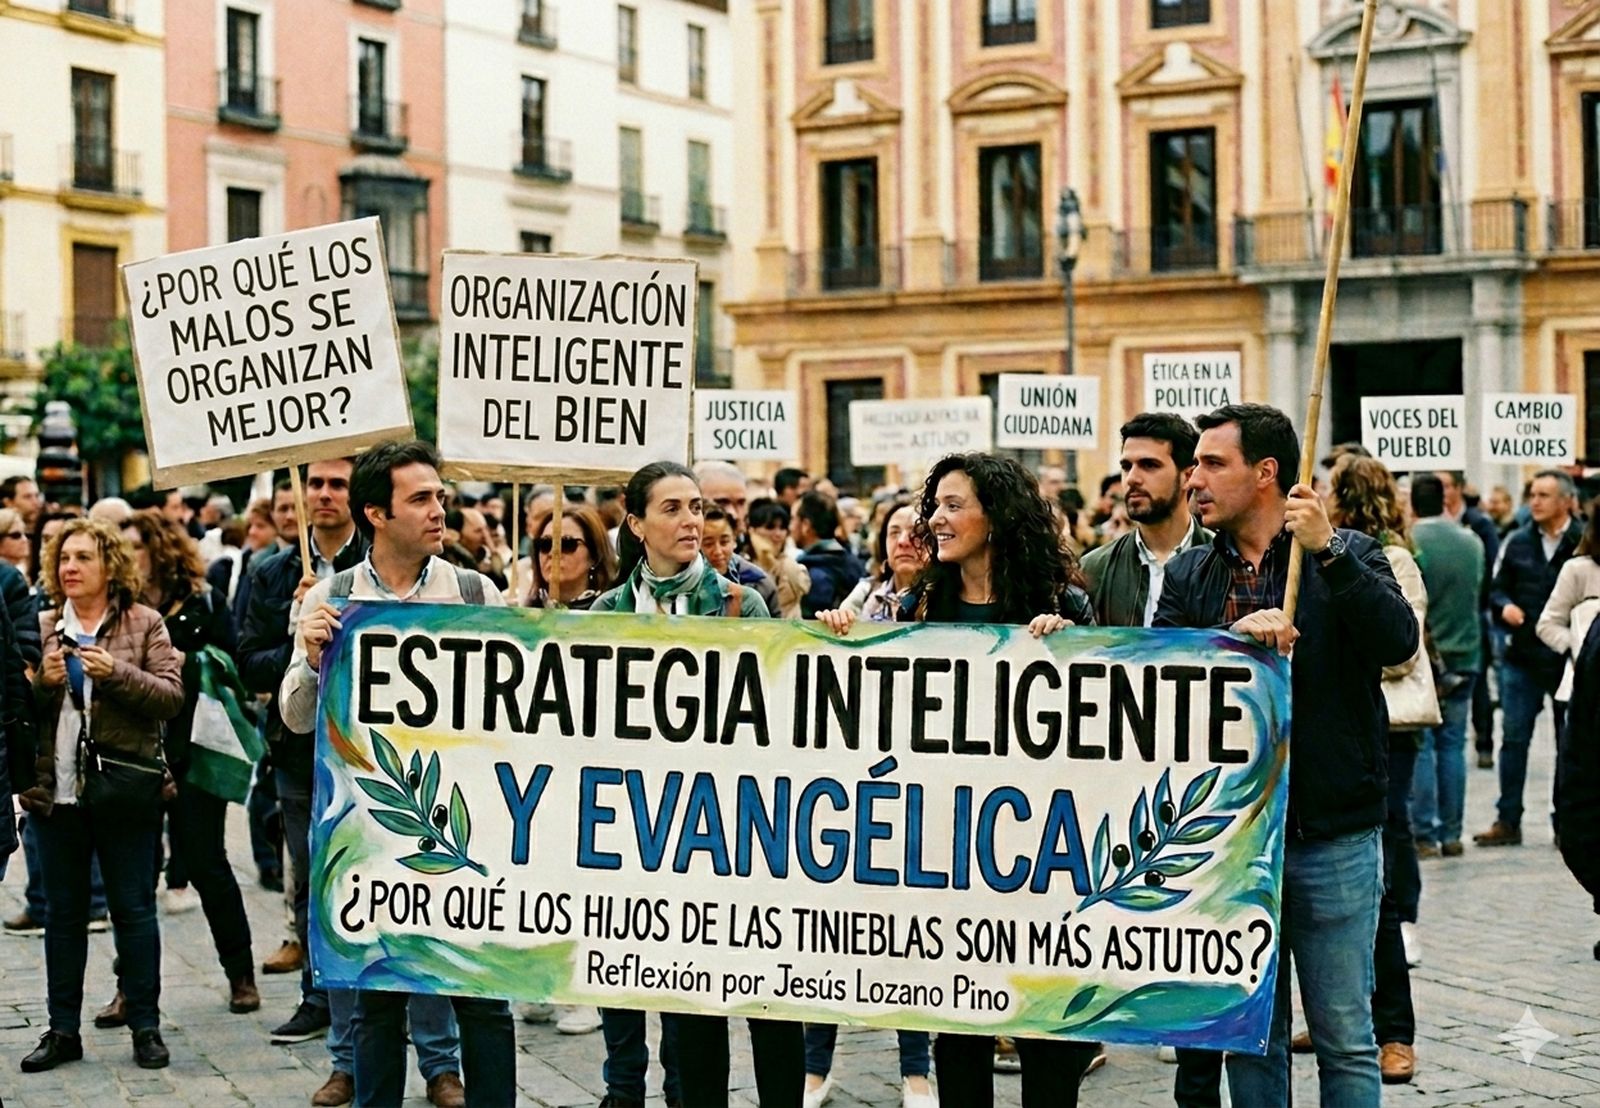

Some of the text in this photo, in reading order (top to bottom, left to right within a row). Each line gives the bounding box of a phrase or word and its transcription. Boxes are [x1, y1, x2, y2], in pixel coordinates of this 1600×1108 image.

[141, 238, 372, 319] ¿POR QUÉ LOS
[450, 270, 686, 328] ORGANIZACIÓN
[170, 289, 356, 356] MALOS SE
[167, 334, 373, 405] ORGANIZAN
[453, 332, 684, 390] INTELIGENTE
[1153, 358, 1232, 380] ÉTICA EN LA
[705, 400, 785, 422] JUSTICIA
[1020, 382, 1077, 408] UNIÓN
[1155, 384, 1231, 408] POLÍTICA
[1495, 400, 1563, 420] CAMBIO
[207, 387, 351, 447] MEJOR?
[483, 395, 647, 446] DEL BIEN
[1004, 415, 1093, 436] CIUDADANA
[1369, 408, 1458, 430] VOCES DEL
[1516, 423, 1541, 435] CON
[713, 428, 778, 450] SOCIAL
[1377, 436, 1451, 458] PUEBLO
[1489, 438, 1568, 457] VALORES
[357, 633, 1253, 765] ESTRATEGIA INTELIGENTE
[494, 755, 1093, 897] Y EVANGÉLICA
[340, 873, 1273, 984] ¿POR QUÉ LOS HIJOS DE LAS TINIEBLAS SON MÁS ASTUTOS?
[587, 950, 1010, 1012] Reflexión por Jesús Lozano Pino
